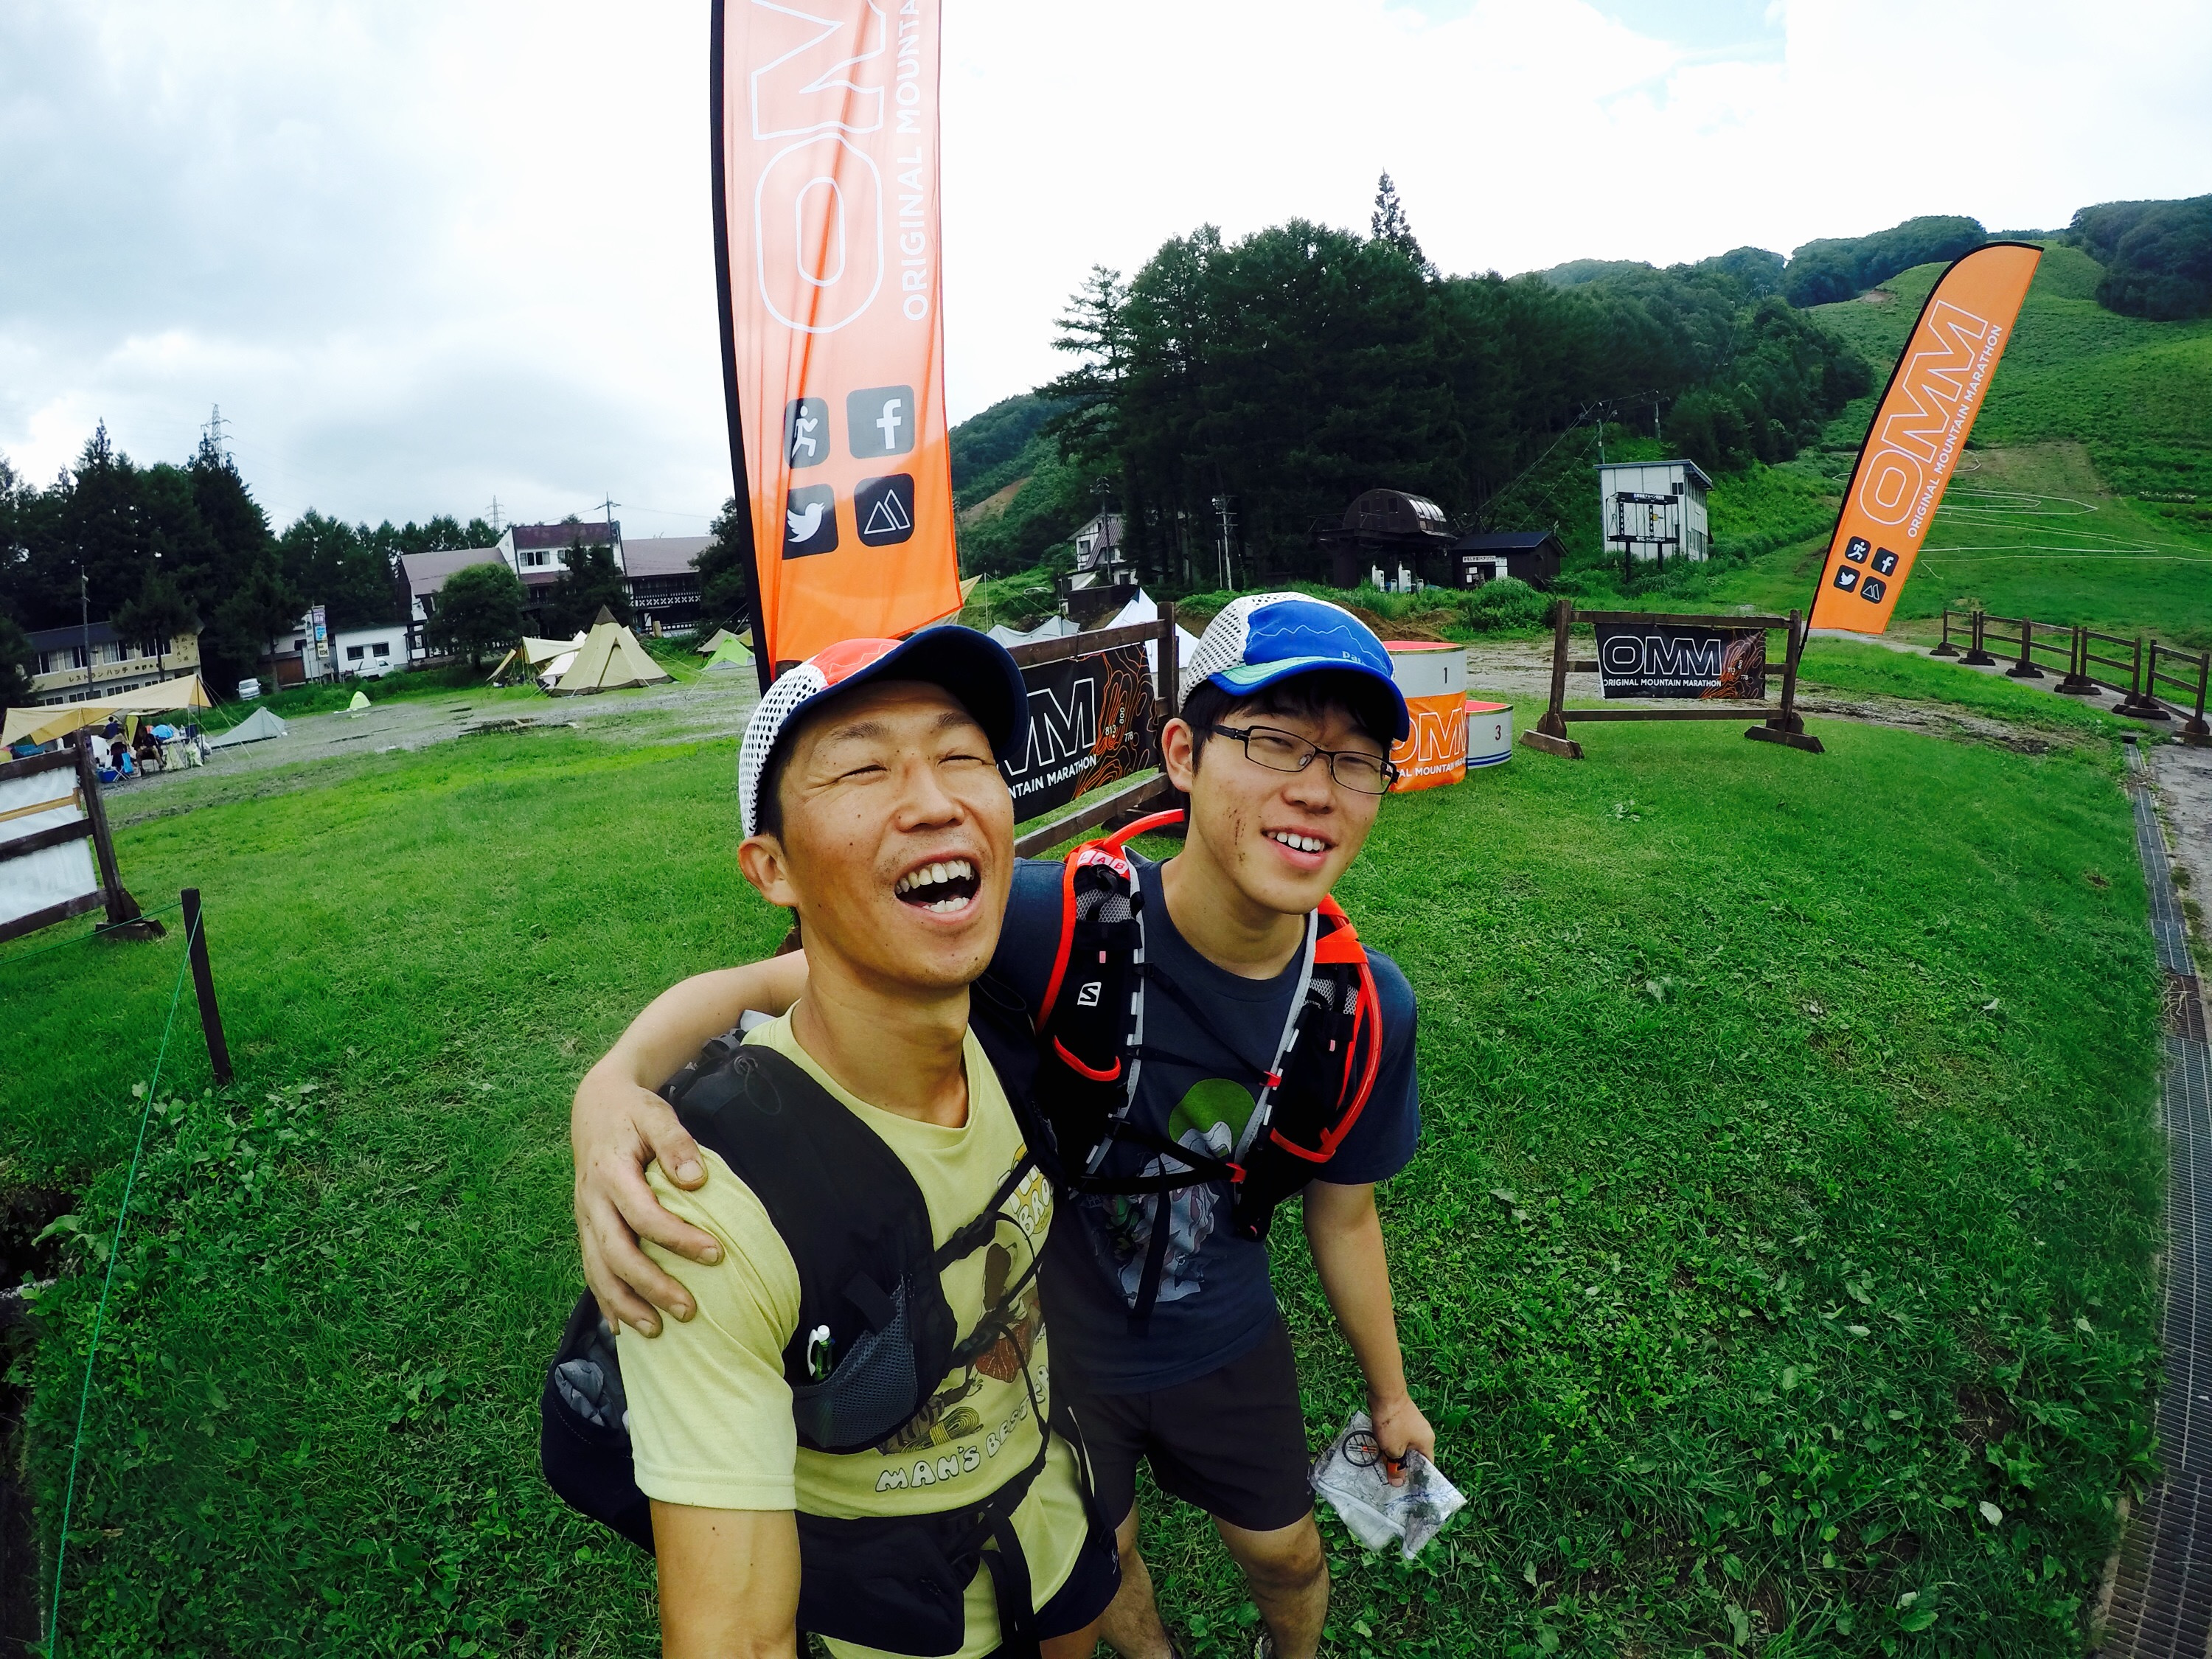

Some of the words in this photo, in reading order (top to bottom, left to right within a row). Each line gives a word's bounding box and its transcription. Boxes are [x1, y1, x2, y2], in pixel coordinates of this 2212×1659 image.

[896, 0, 921, 133] MOUNTA
[897, 146, 928, 321] ORIGINAL
[1859, 299, 1989, 526] OMM
[1907, 478, 1941, 538] ORIGINAL
[1933, 403, 1970, 475] MOUNTAIN
[1964, 324, 2003, 403] MARATHON
[1443, 667, 1448, 684] 1
[1603, 636, 1722, 676] OMM
[1603, 678, 1638, 686] ORIGINAL
[1641, 678, 1681, 687] MOUNTAIN
[1683, 679, 1722, 687] MARATHON
[1105, 724, 1117, 736] 813
[1495, 724, 1502, 742] 3
[1007, 776, 1045, 799] NTAIN
[1046, 754, 1097, 787] MARATHON
[1018, 1178, 1054, 1239] BRO
[875, 1445, 981, 1493] MAN'S
[985, 1393, 1030, 1458] BEST
